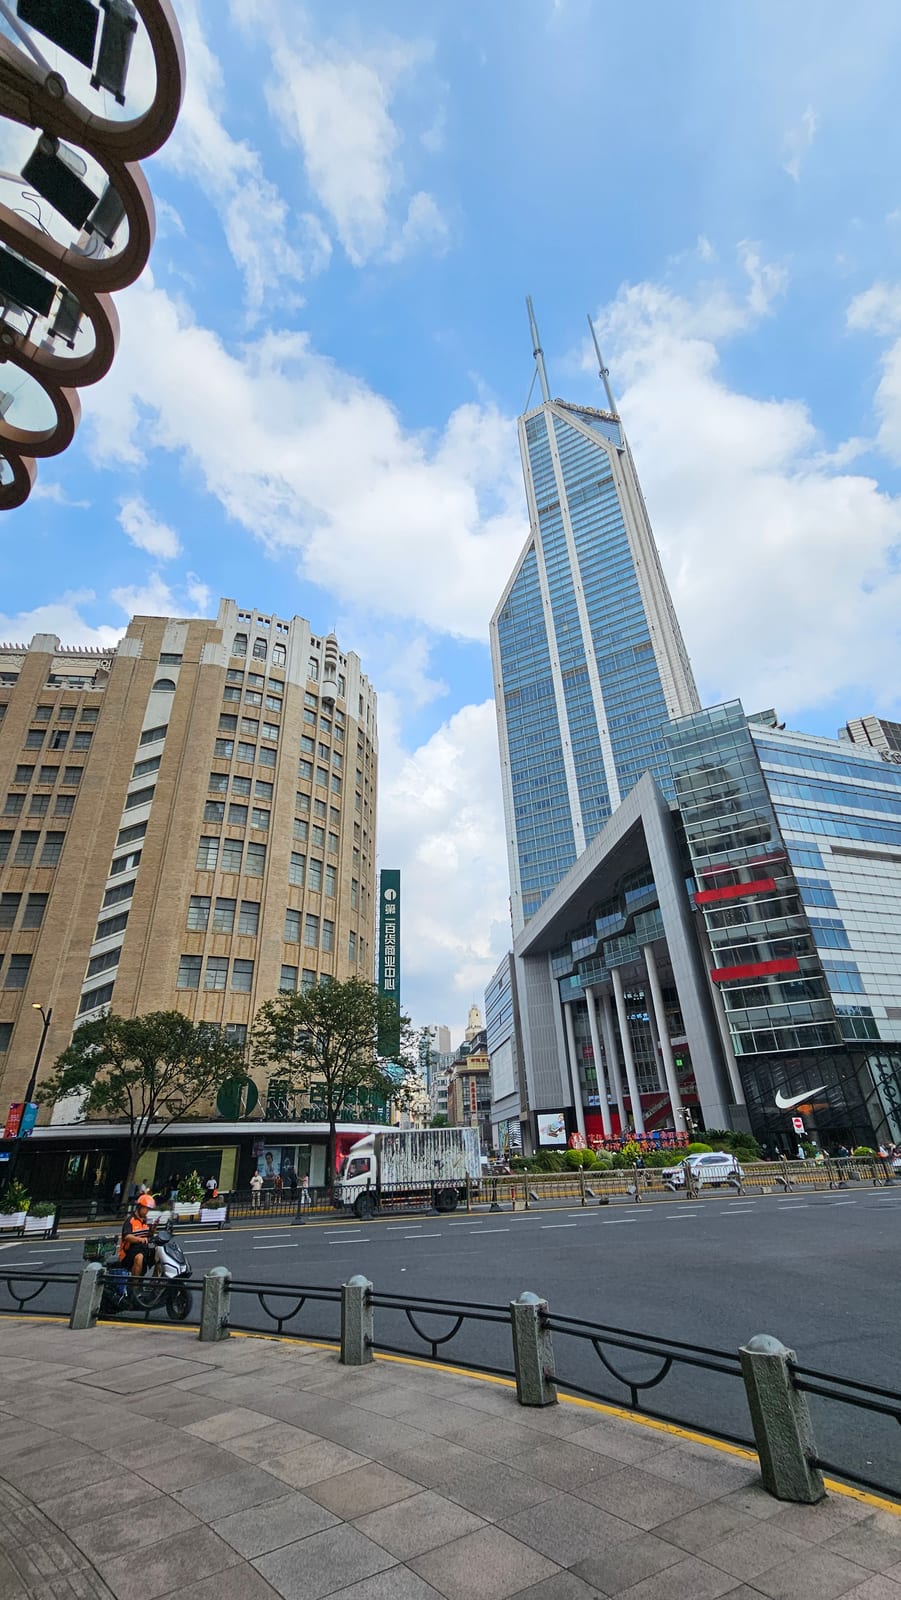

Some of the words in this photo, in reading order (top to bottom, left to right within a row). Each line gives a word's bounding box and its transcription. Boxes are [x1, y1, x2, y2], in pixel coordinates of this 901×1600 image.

[384, 904, 396, 990] 第一百货商业中心
